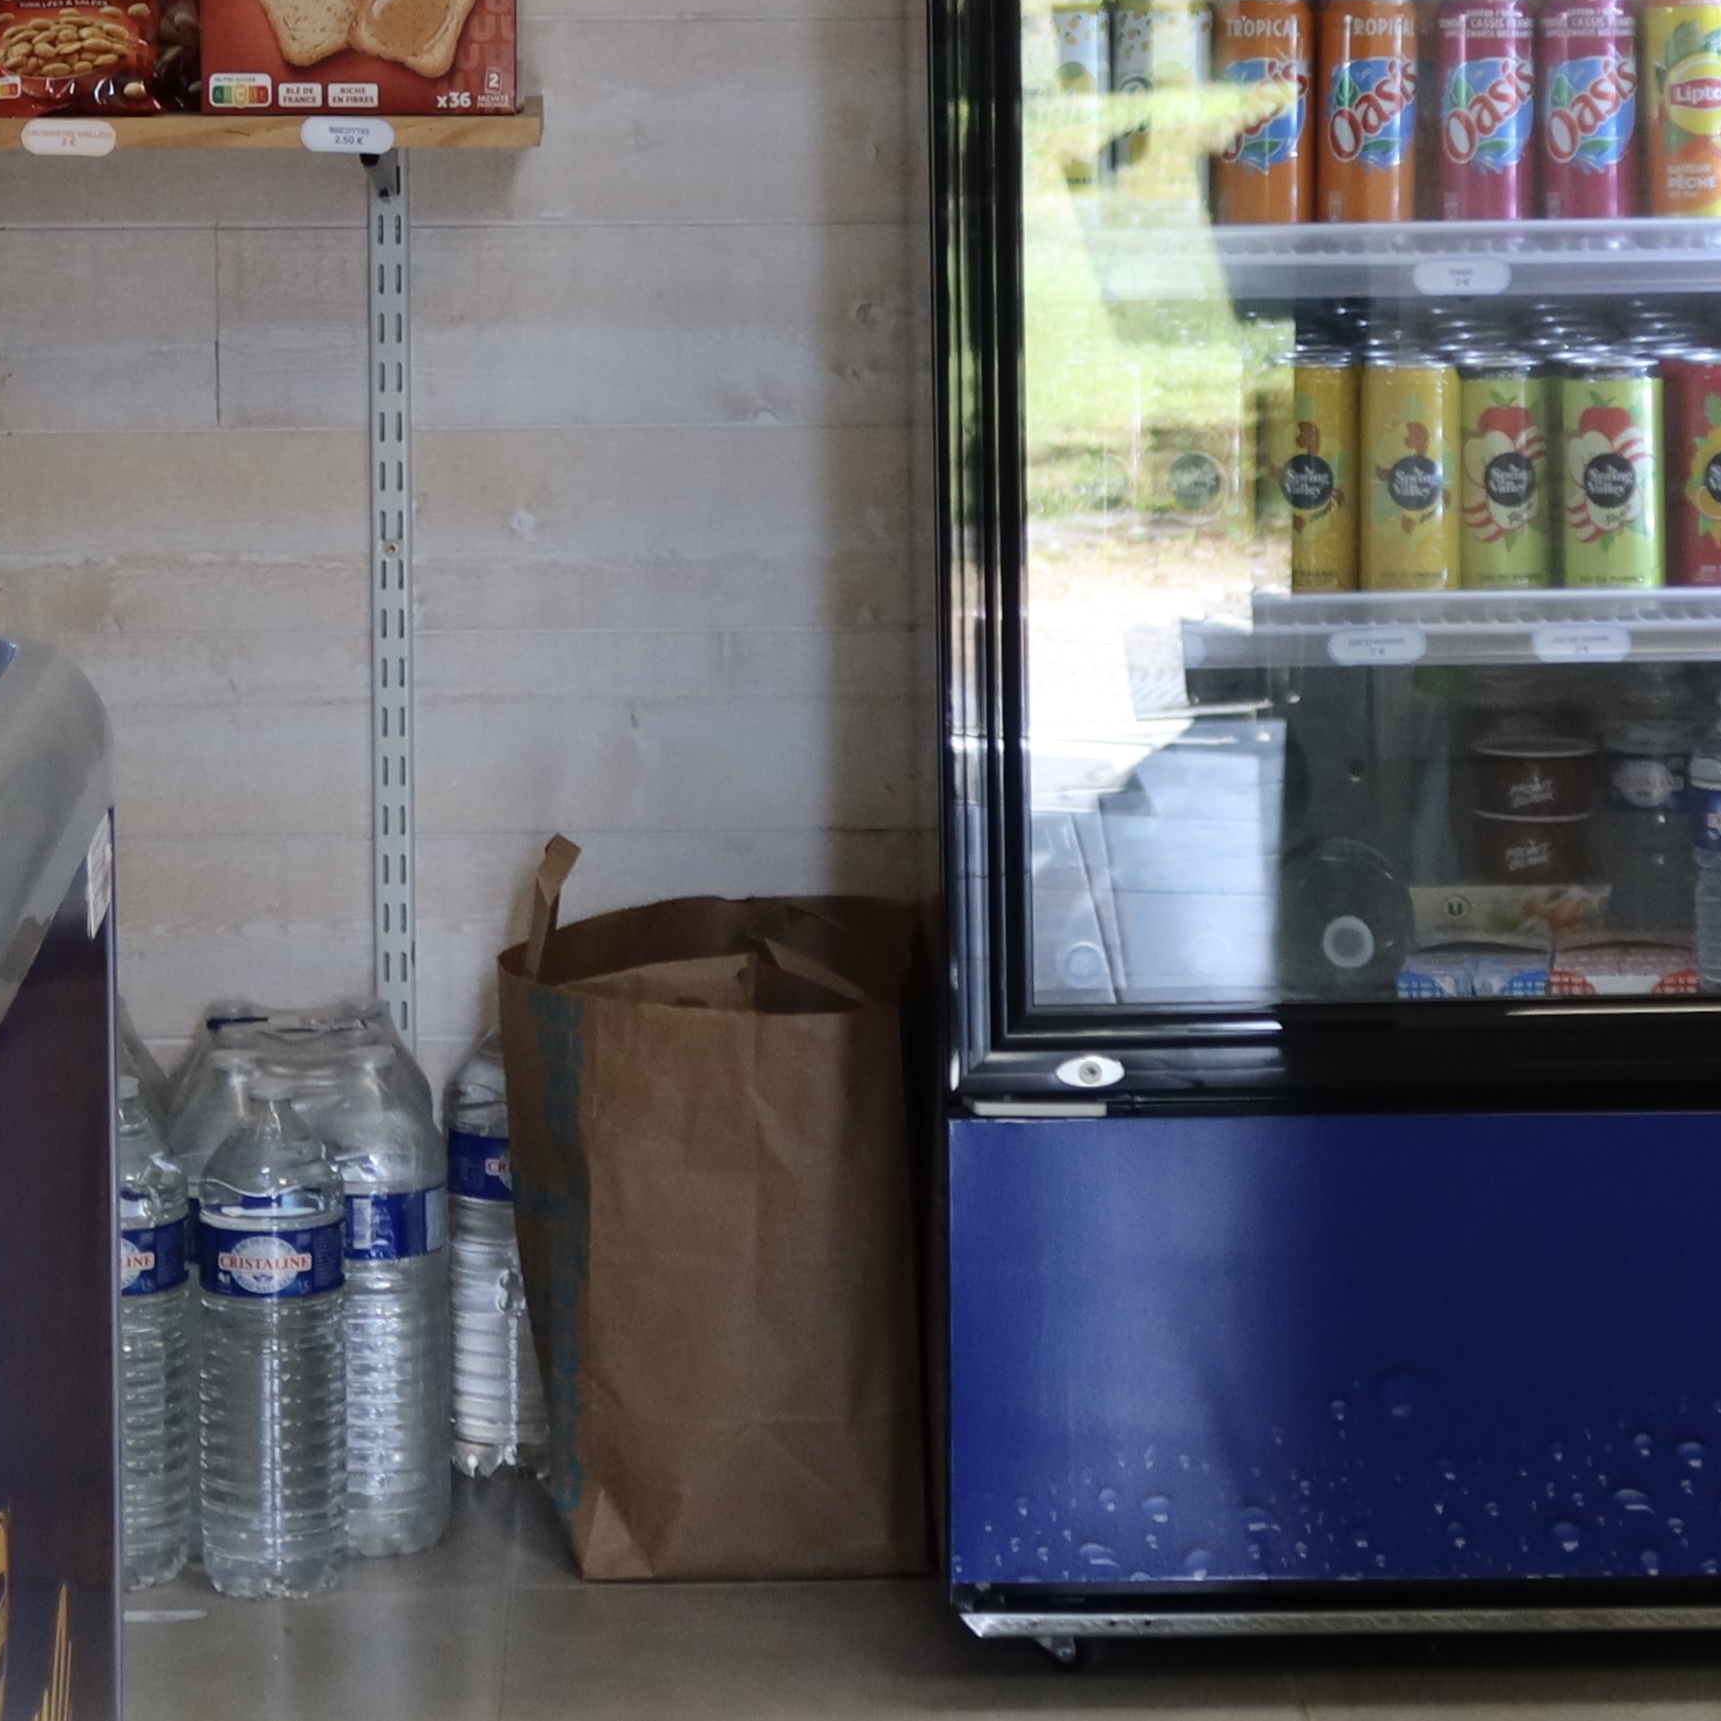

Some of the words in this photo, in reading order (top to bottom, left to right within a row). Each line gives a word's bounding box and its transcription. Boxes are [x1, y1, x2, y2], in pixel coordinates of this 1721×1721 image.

[489, 74, 499, 87] 2
[285, 86, 301, 96] BLÉ
[302, 87, 314, 96] DE
[339, 86, 366, 96] RICHE
[283, 95, 317, 105] FRANCE
[332, 95, 347, 105] EN
[349, 95, 379, 105] FIBRES
[436, 93, 472, 108] x36
[328, 126, 370, 136] BISCOTTES
[334, 136, 355, 146] 2.50
[1284, 484, 1323, 499] Valley
[219, 1252, 313, 1271] CRISTALINE
